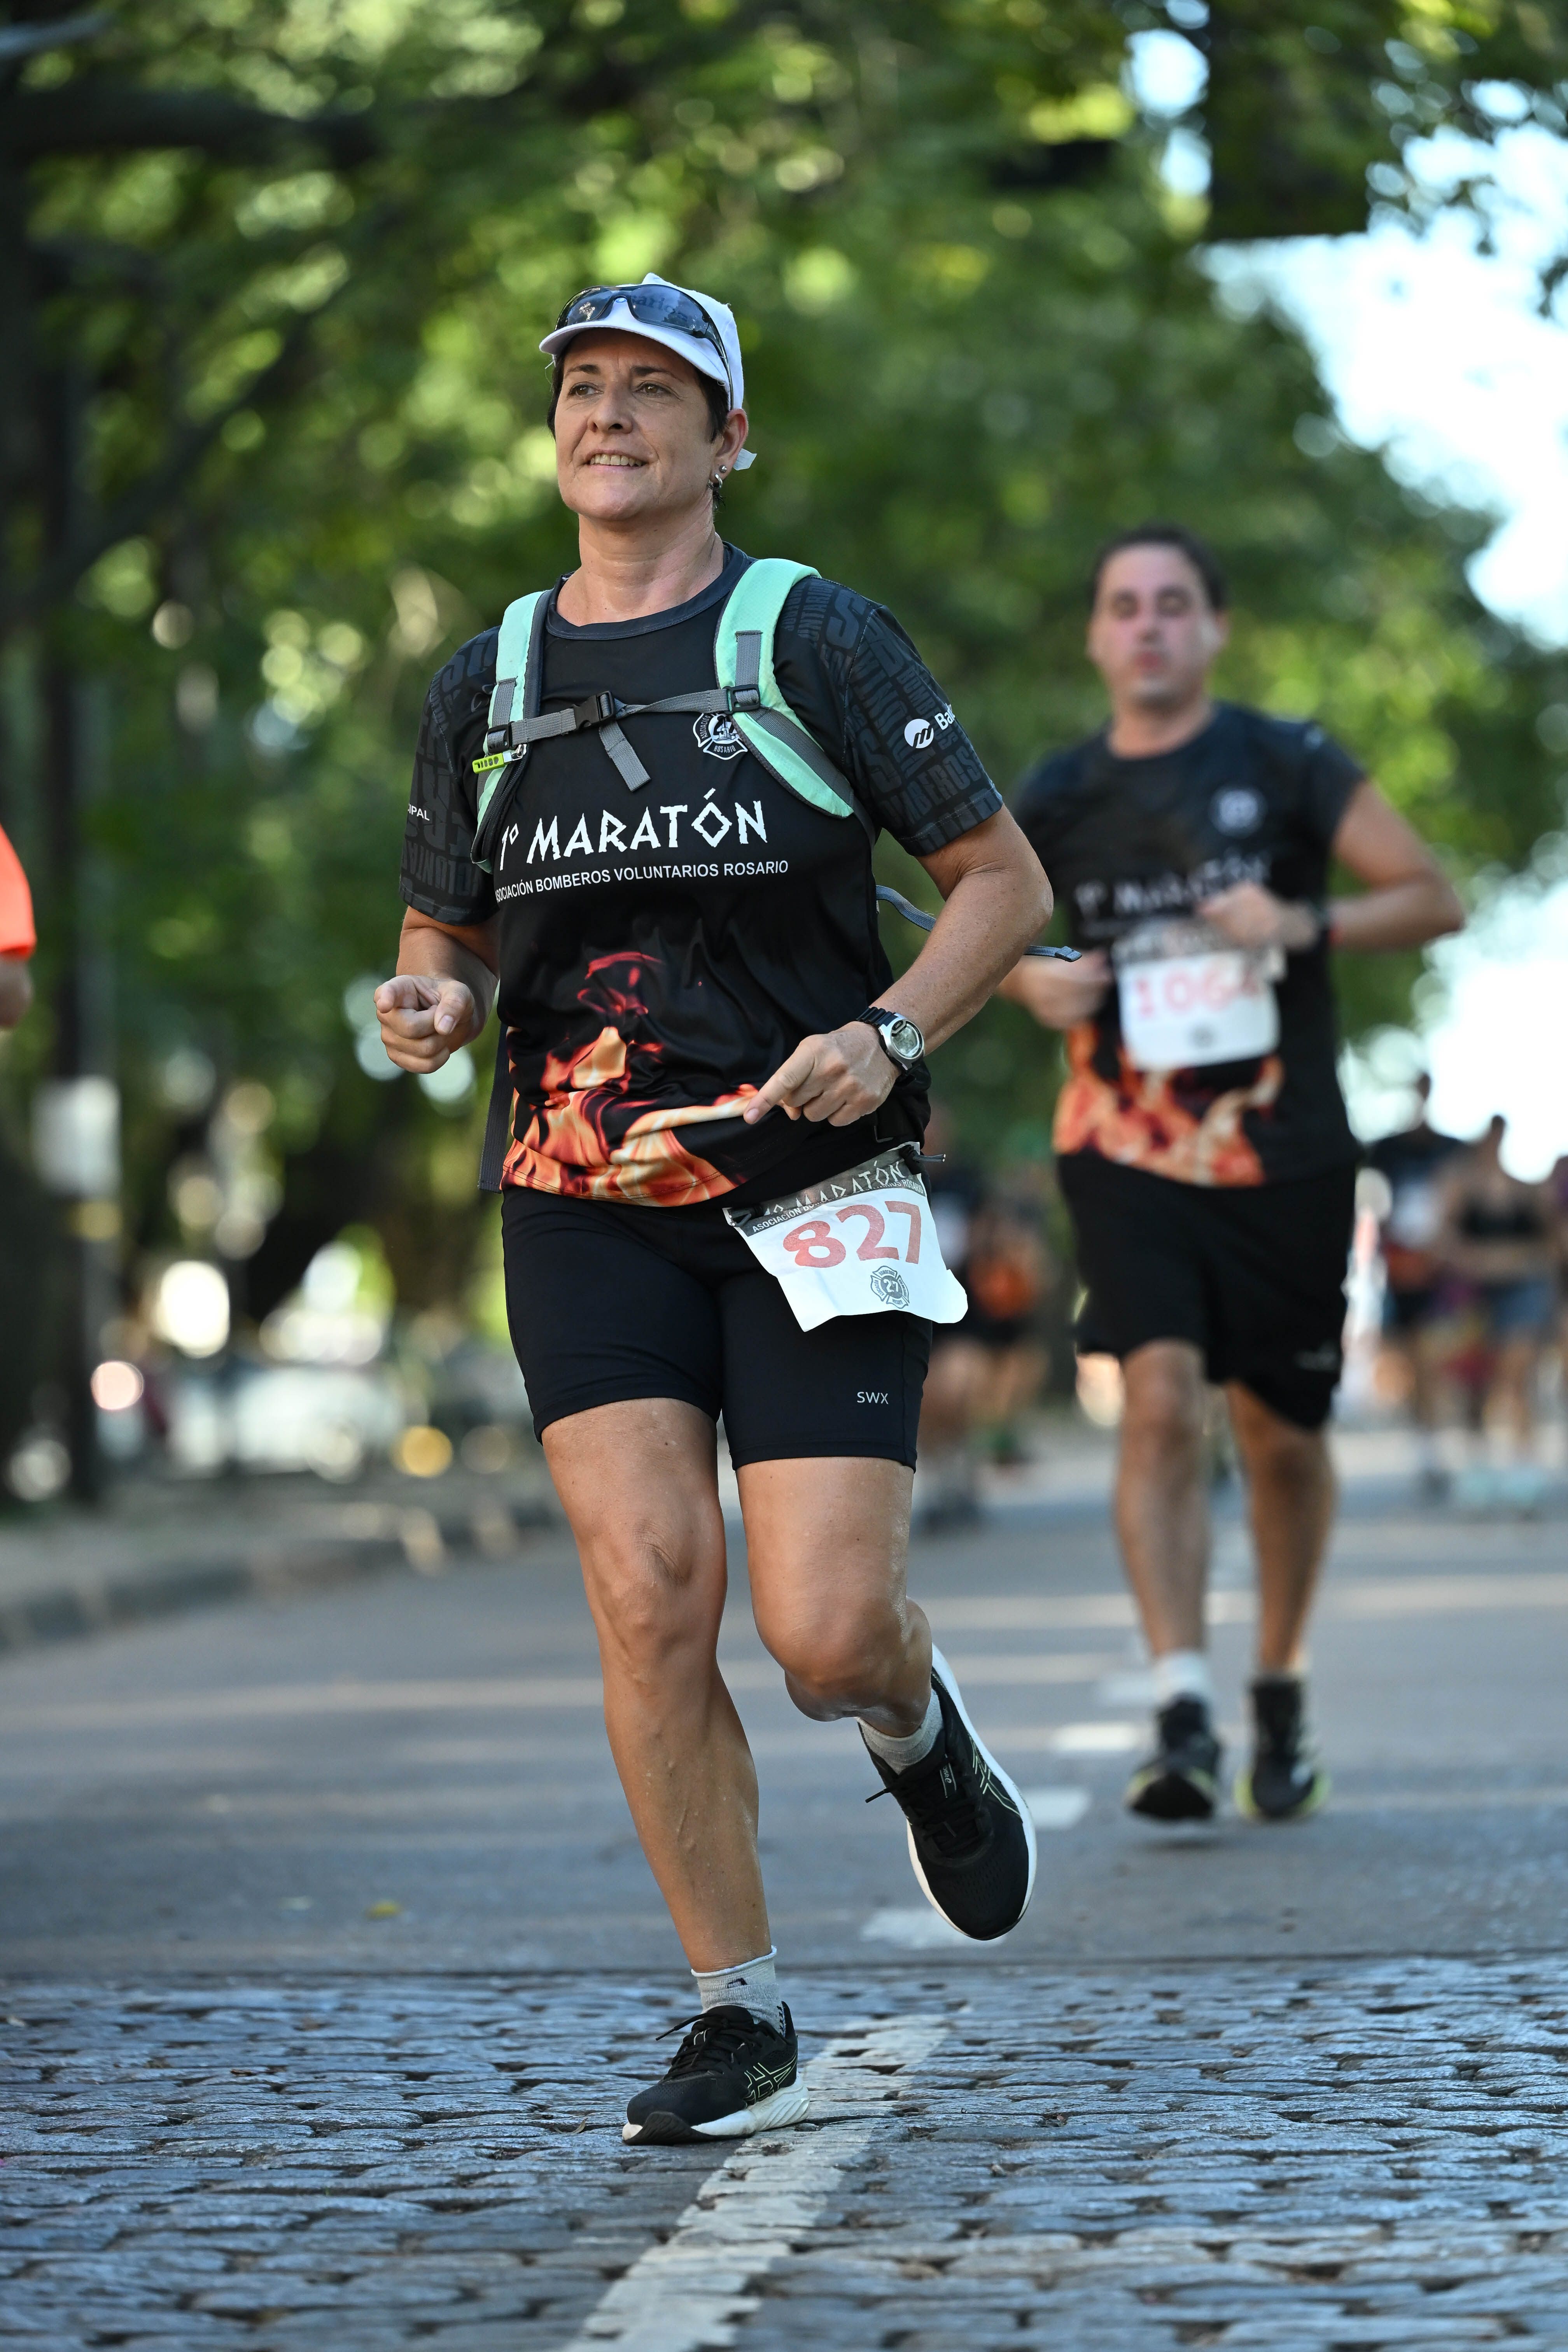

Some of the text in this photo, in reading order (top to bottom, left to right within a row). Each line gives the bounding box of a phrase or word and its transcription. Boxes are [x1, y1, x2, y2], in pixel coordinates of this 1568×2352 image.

[714, 745, 736, 753] ROSARIO
[408, 803, 430, 821] IPAL
[527, 788, 768, 864] MARATÓN
[536, 869, 611, 892] BOMBEROS
[614, 864, 719, 881] VOLUNTARIOS
[724, 860, 788, 876] ROSARIO
[901, 1179, 924, 1194] ROSARIO
[783, 1201, 921, 1268] 827
[883, 1278, 899, 1293] 27
[857, 1391, 889, 1404] SWX
